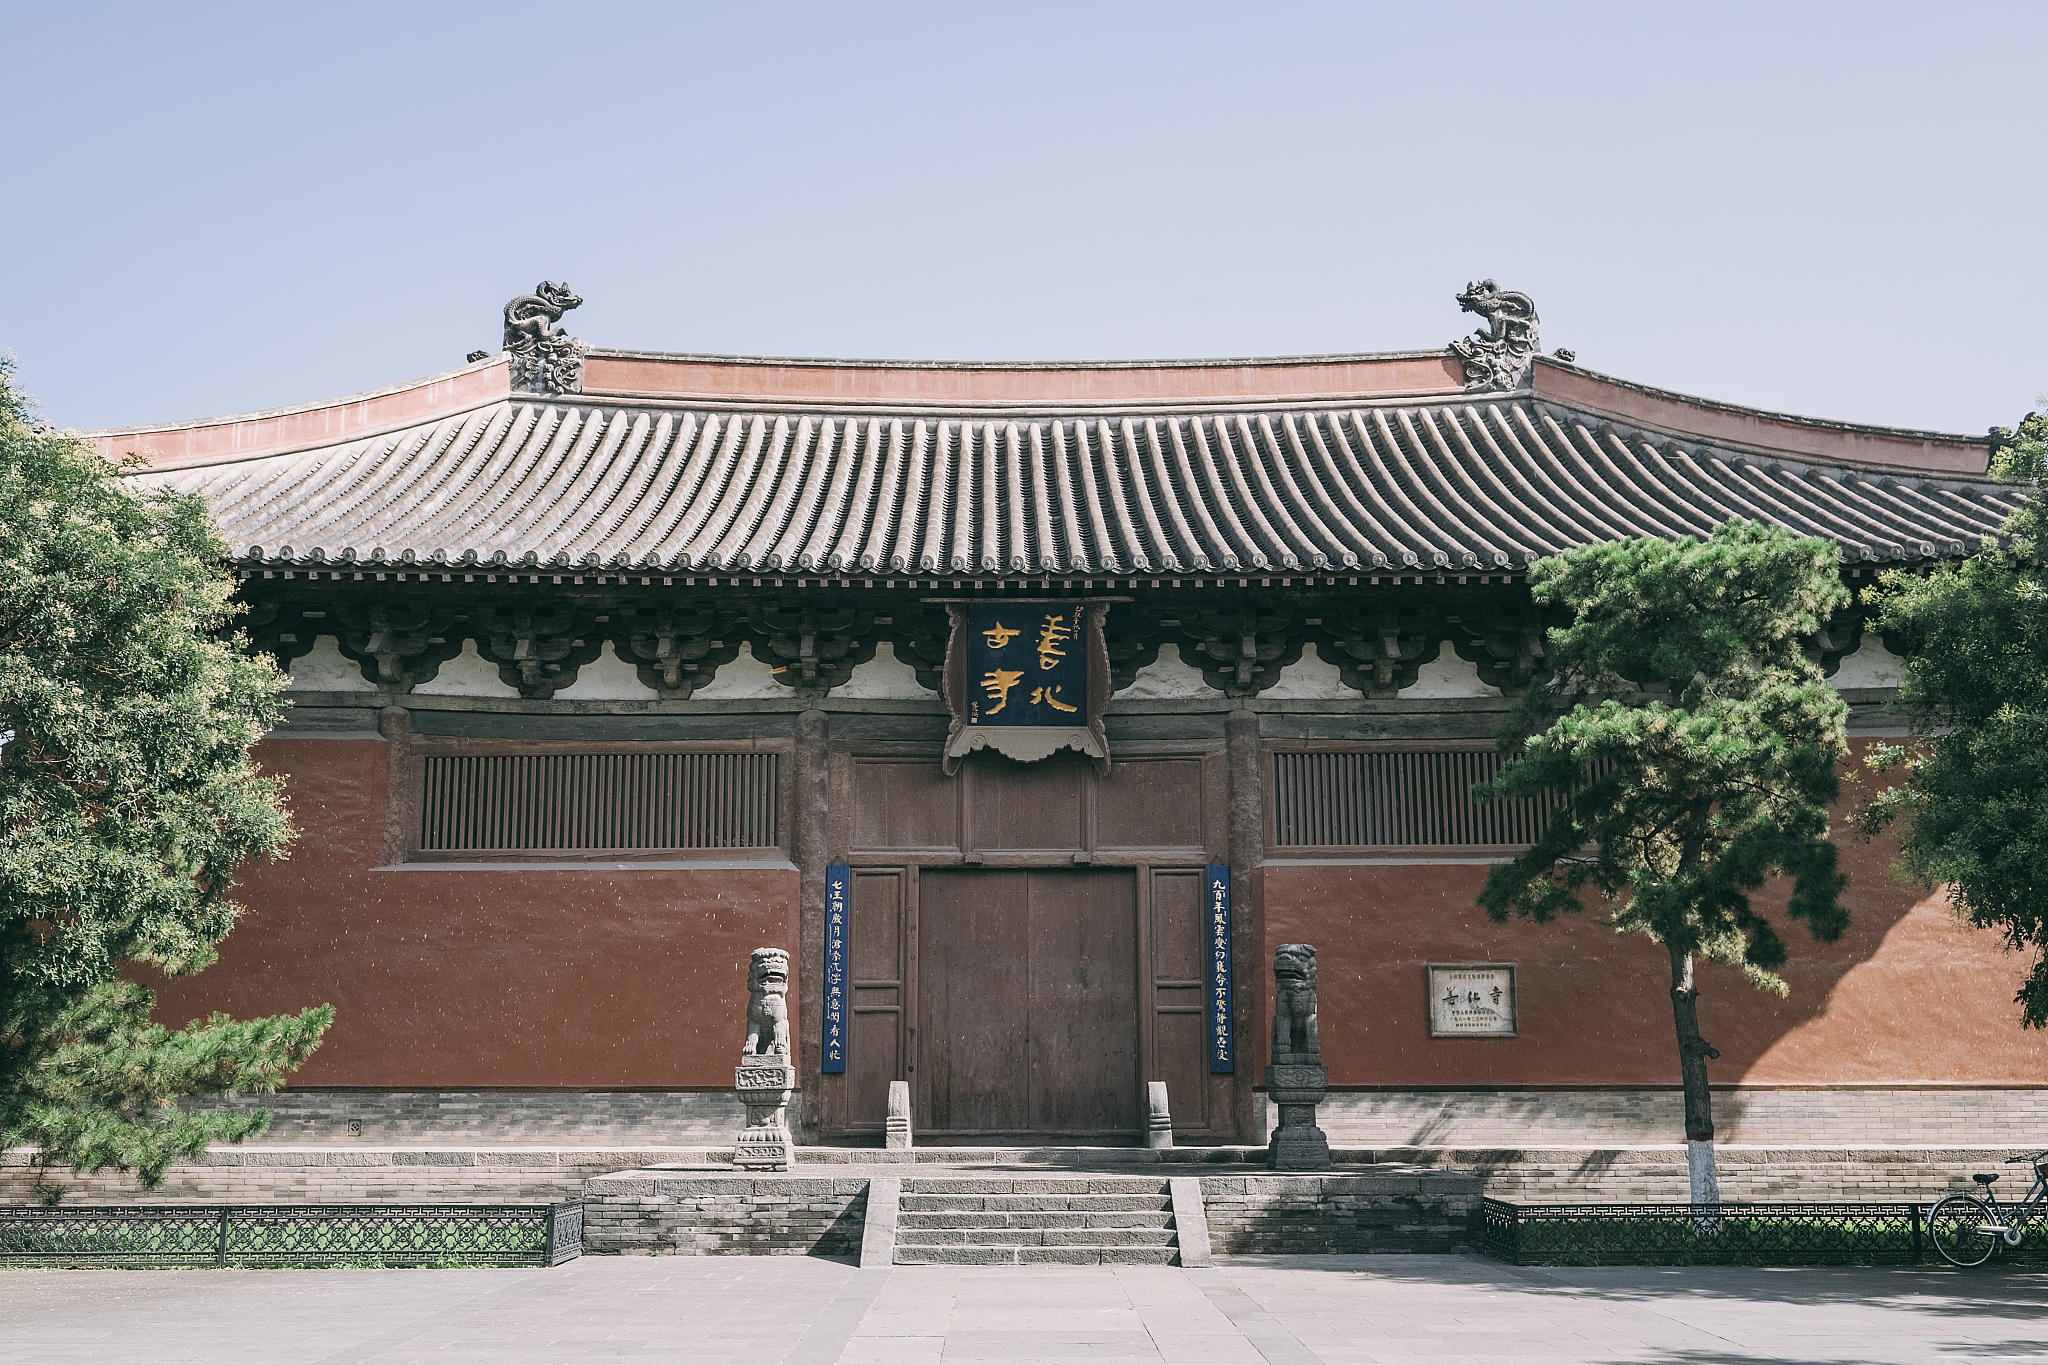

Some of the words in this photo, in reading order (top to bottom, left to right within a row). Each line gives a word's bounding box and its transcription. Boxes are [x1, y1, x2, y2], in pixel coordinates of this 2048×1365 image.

[1030, 614, 1077, 713] 善化
[1442, 985, 1503, 1005] 善化寺
